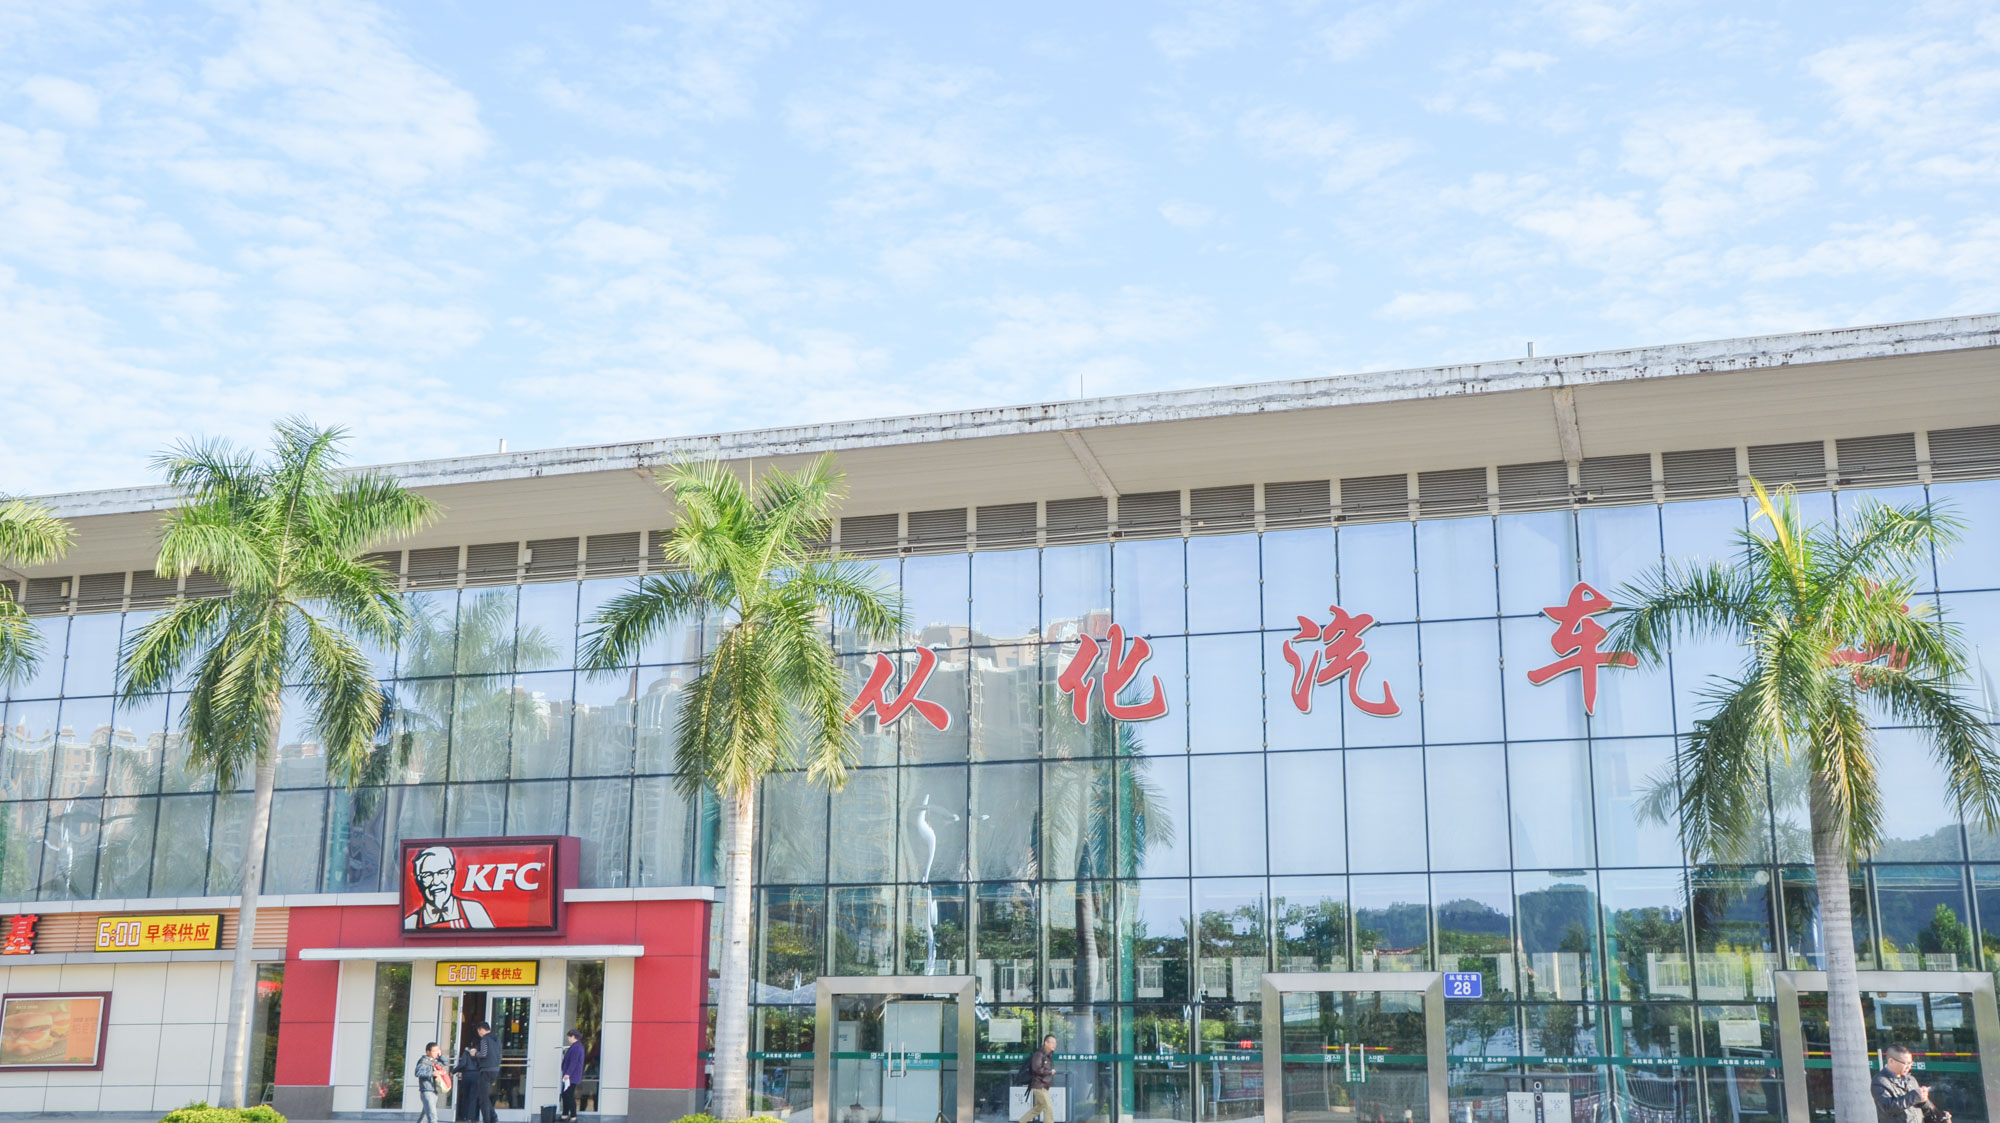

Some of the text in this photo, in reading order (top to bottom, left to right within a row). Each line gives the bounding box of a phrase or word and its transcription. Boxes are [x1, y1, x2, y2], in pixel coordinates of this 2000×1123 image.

[461, 863, 542, 892] KFC
[3, 914, 39, 955] 基
[98, 921, 211, 947] 6:00 早餐供应
[448, 965, 523, 982] 6:00 早餐供应
[1454, 981, 1471, 995] 28
